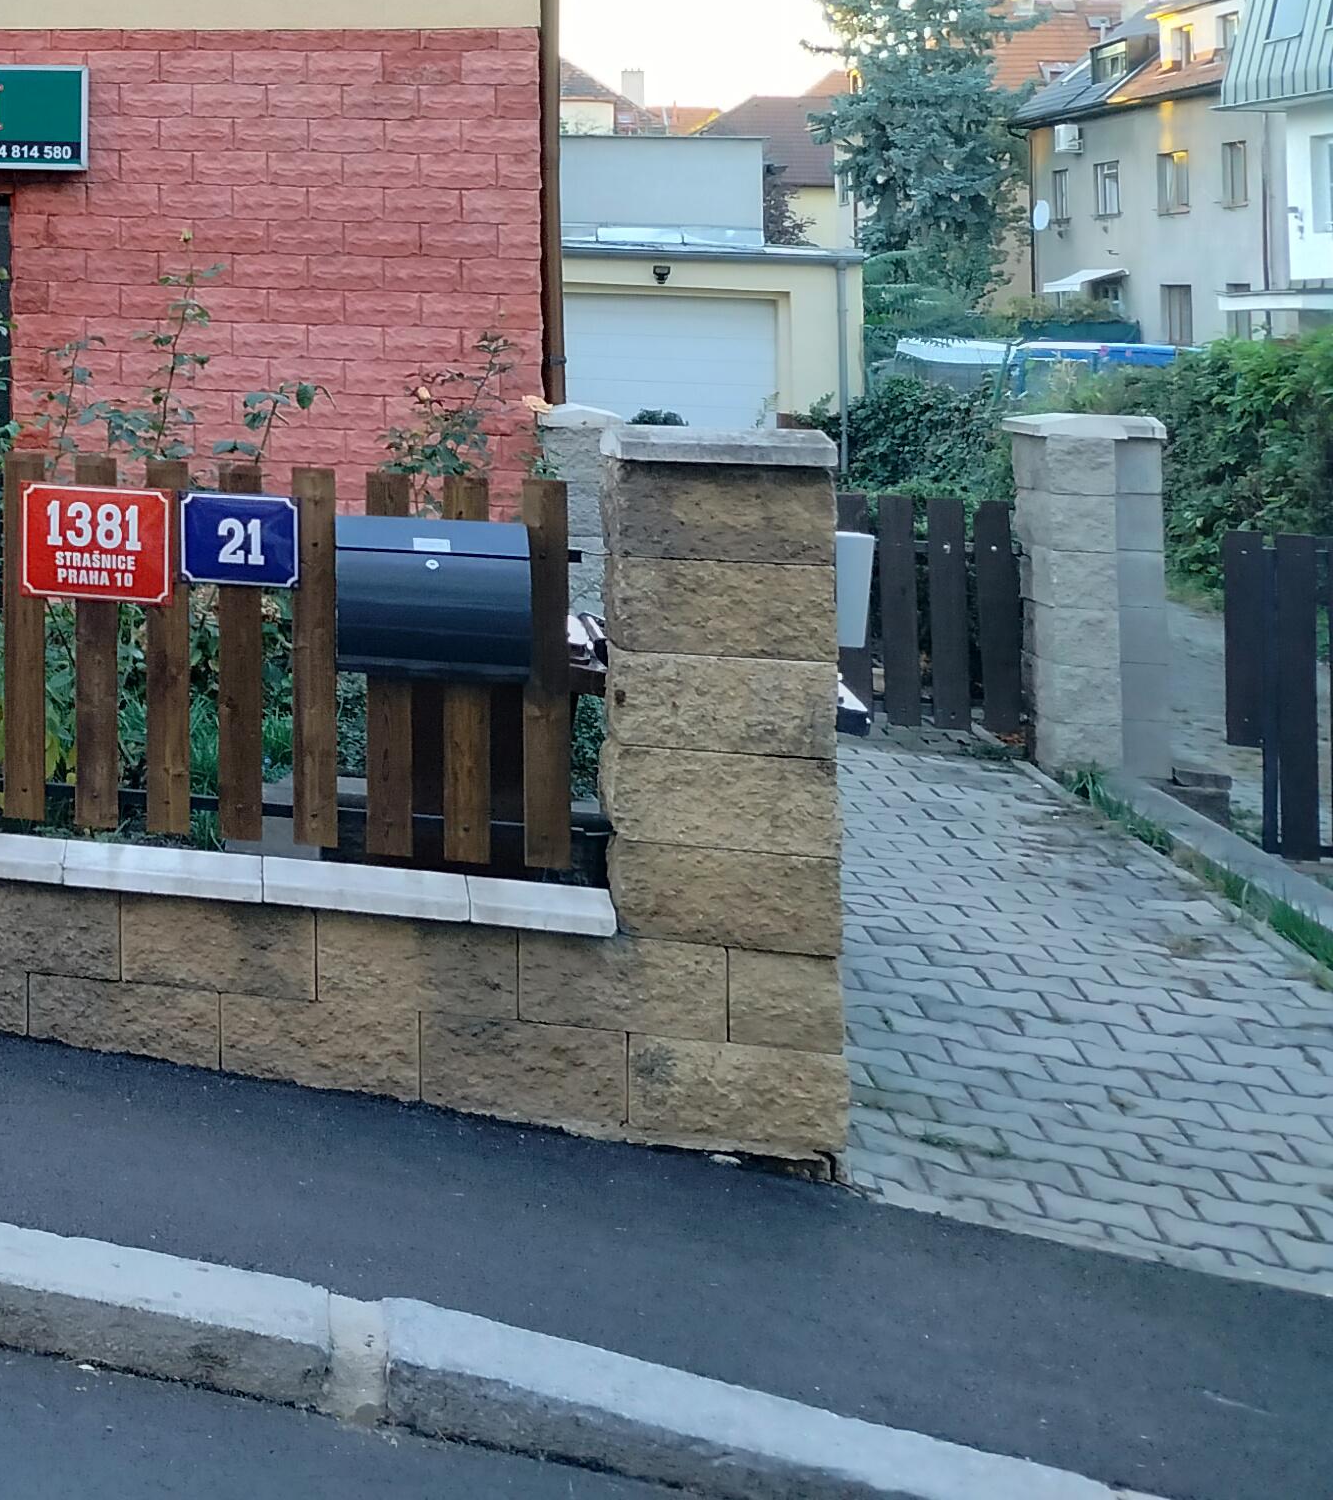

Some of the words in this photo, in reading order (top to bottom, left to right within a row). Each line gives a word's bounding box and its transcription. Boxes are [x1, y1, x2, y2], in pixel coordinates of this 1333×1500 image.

[11, 145, 40, 158] 814
[43, 146, 72, 159] 580
[46, 499, 142, 551] 1381
[217, 518, 266, 566] 21
[55, 550, 136, 571] STRAŠNICE
[57, 568, 110, 586] PRAHA
[113, 572, 133, 587] 10
